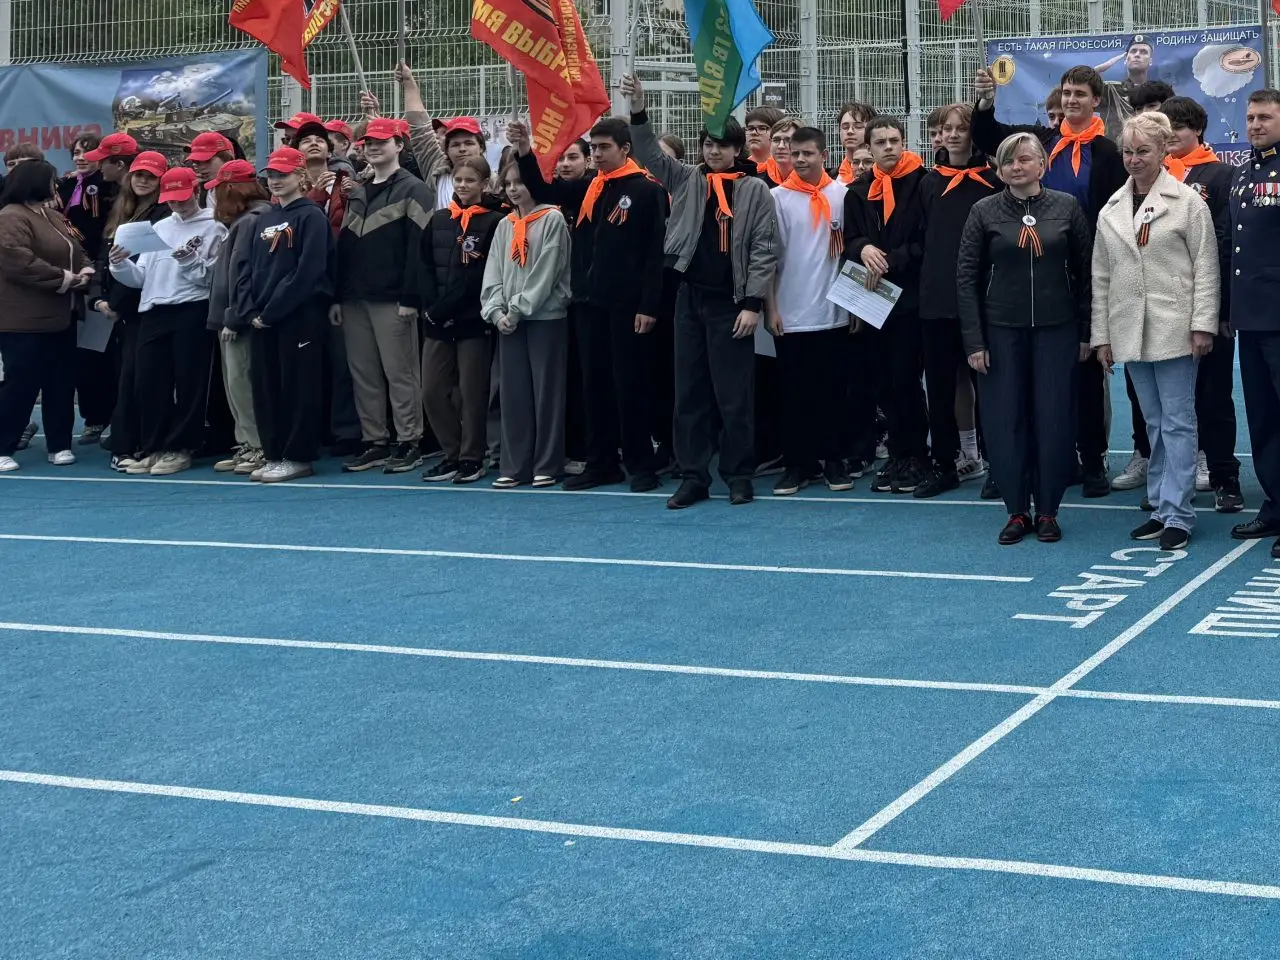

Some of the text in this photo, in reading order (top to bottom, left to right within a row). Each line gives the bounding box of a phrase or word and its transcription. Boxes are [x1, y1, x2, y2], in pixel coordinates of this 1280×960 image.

[998, 30, 1259, 52] ЕСТЬ ТАКАЯ ПРОФЕССИЯ, РОДИНУ ЗАЩИЩАТЬ
[1011, 547, 1188, 629] СТАРТ
